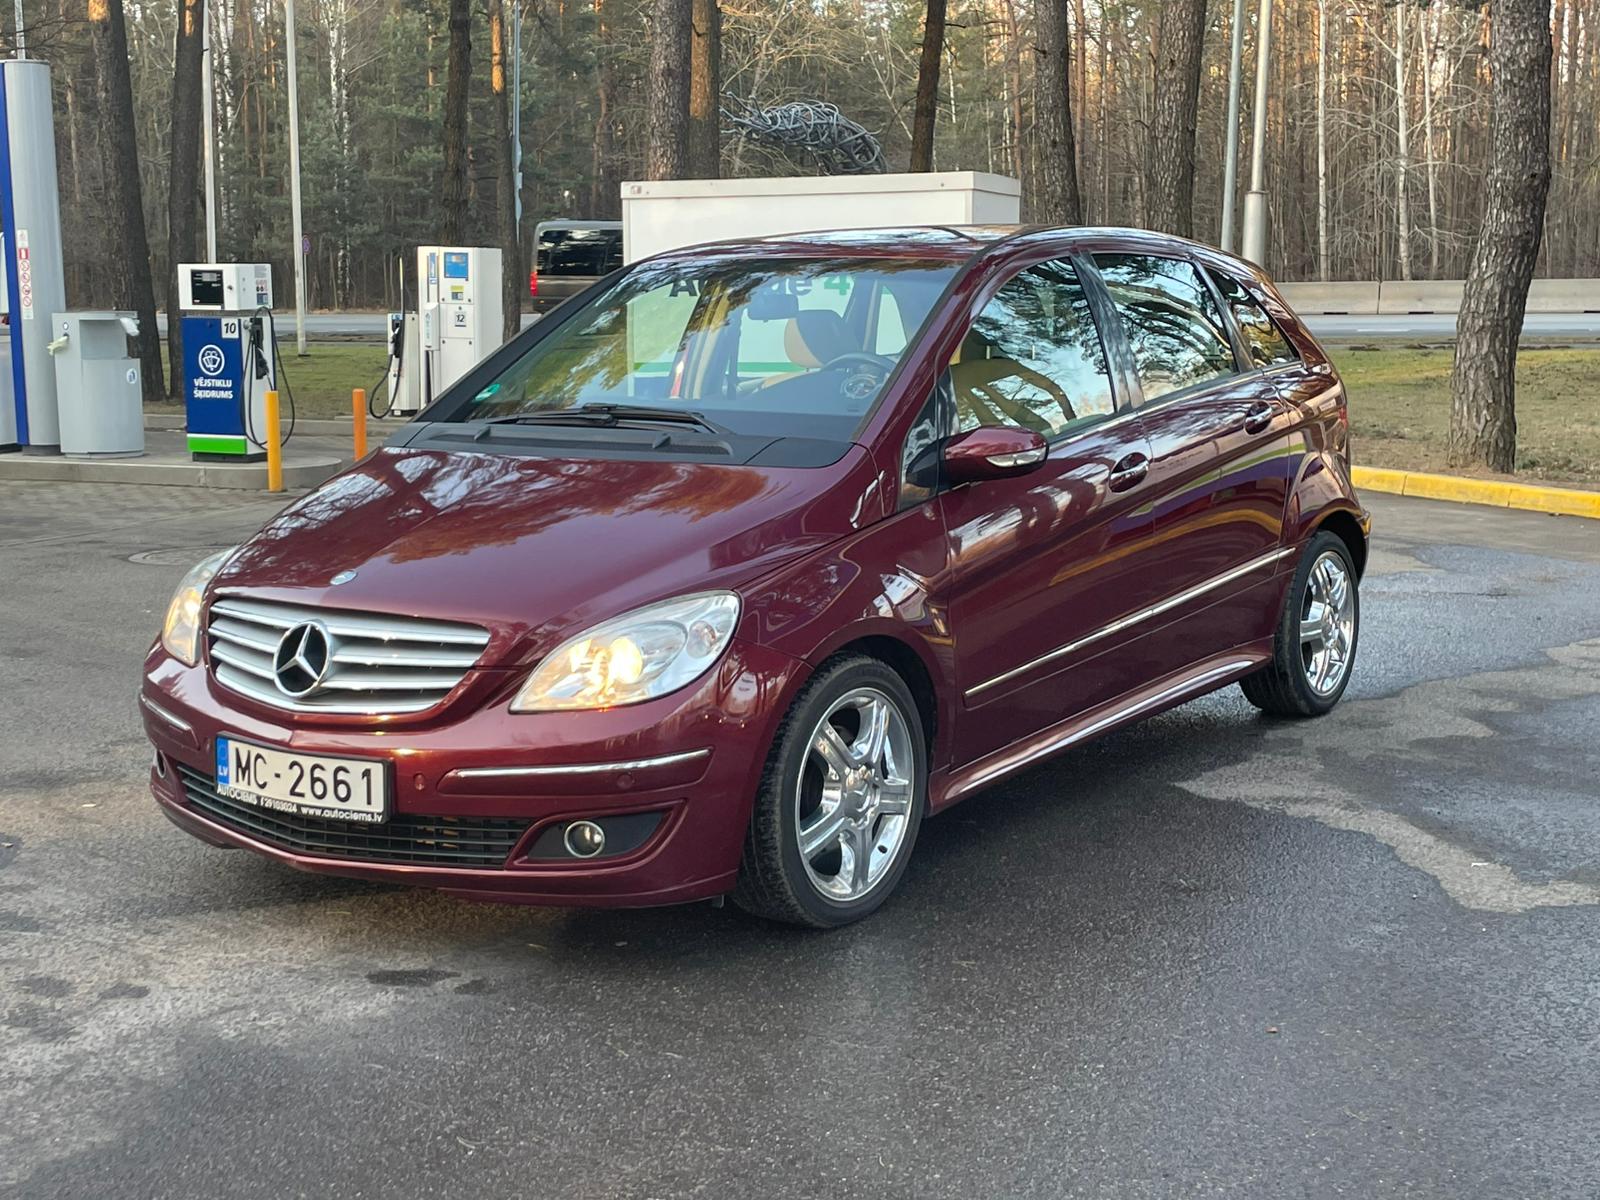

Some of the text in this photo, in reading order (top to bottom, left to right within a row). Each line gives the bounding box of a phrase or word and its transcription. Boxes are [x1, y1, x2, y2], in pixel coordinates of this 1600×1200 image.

[456, 314, 465, 322] 12
[224, 322, 236, 334] 10
[193, 376, 233, 387] VĒJSTIKLU
[218, 765, 228, 777] LV
